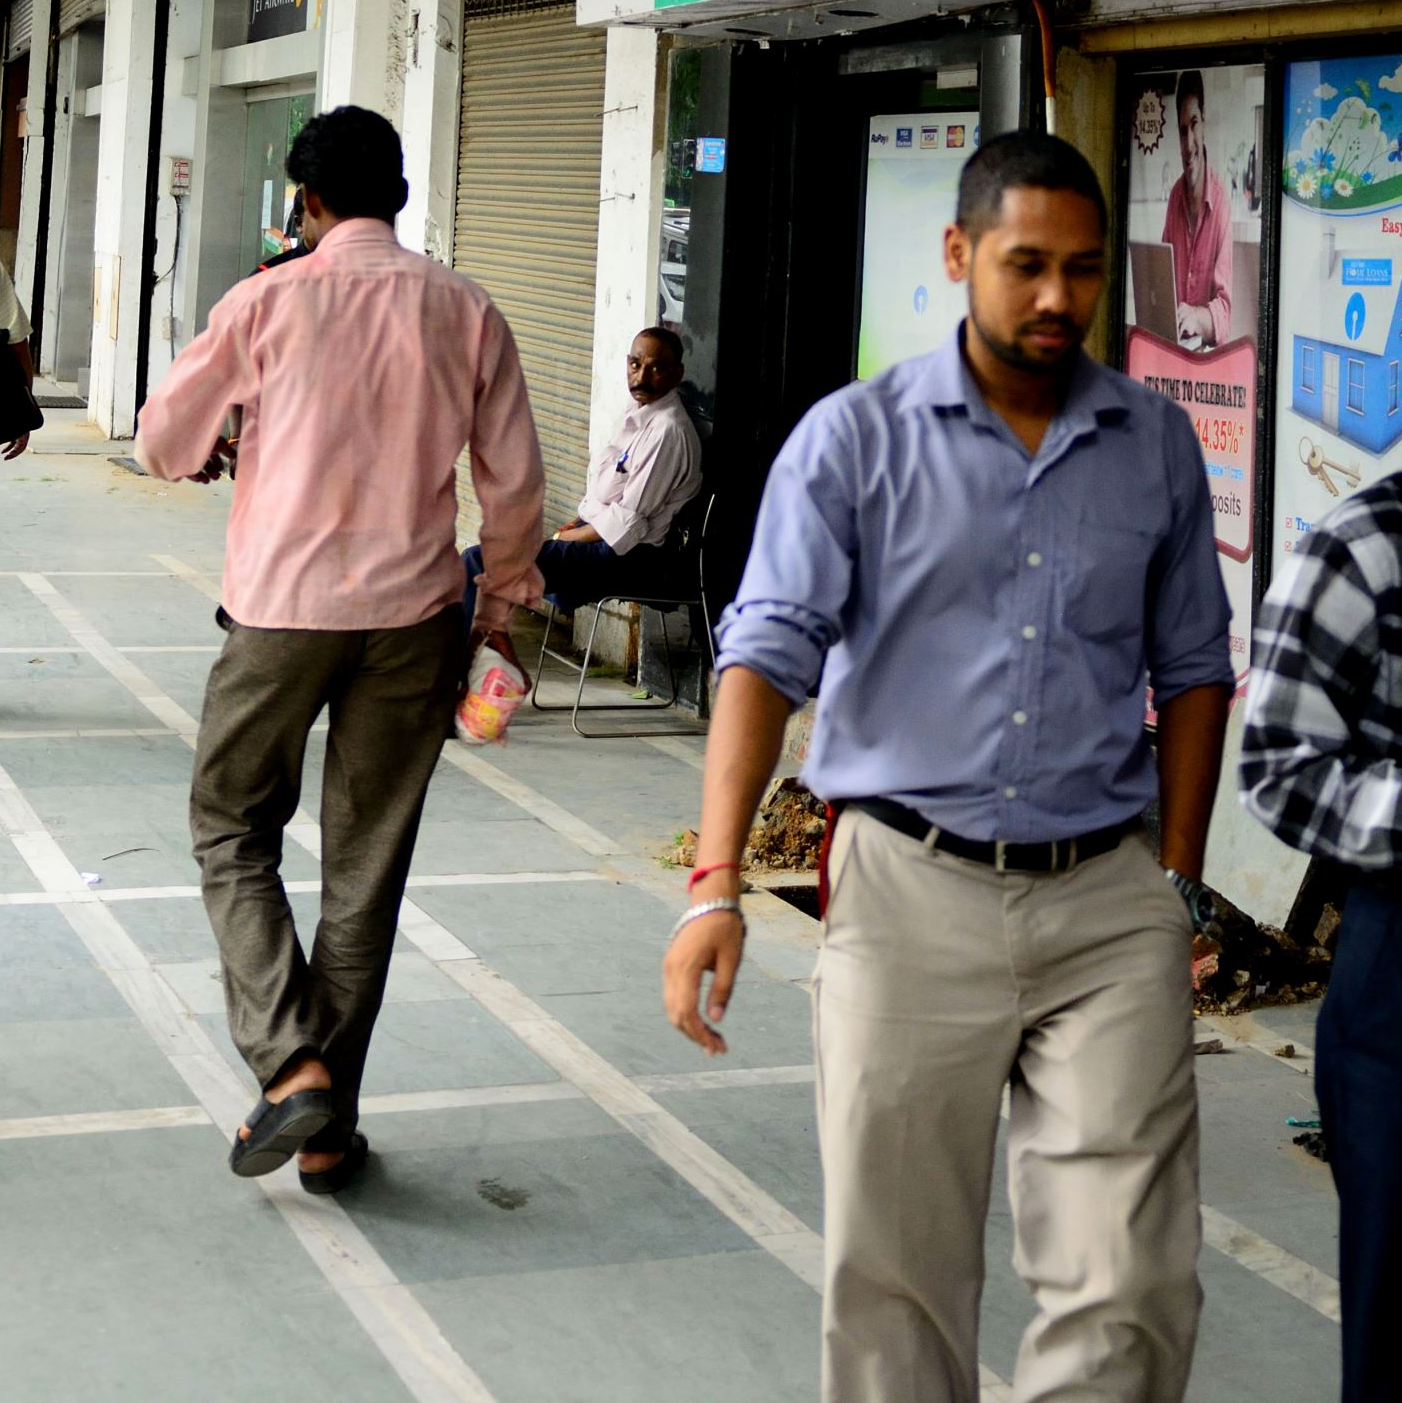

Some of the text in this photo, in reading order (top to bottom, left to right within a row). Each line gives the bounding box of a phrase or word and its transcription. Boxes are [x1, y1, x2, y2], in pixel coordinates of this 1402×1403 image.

[1161, 378, 1180, 401] TIME
[1181, 380, 1193, 402] TO
[1194, 381, 1246, 409] CELEBRATE!
